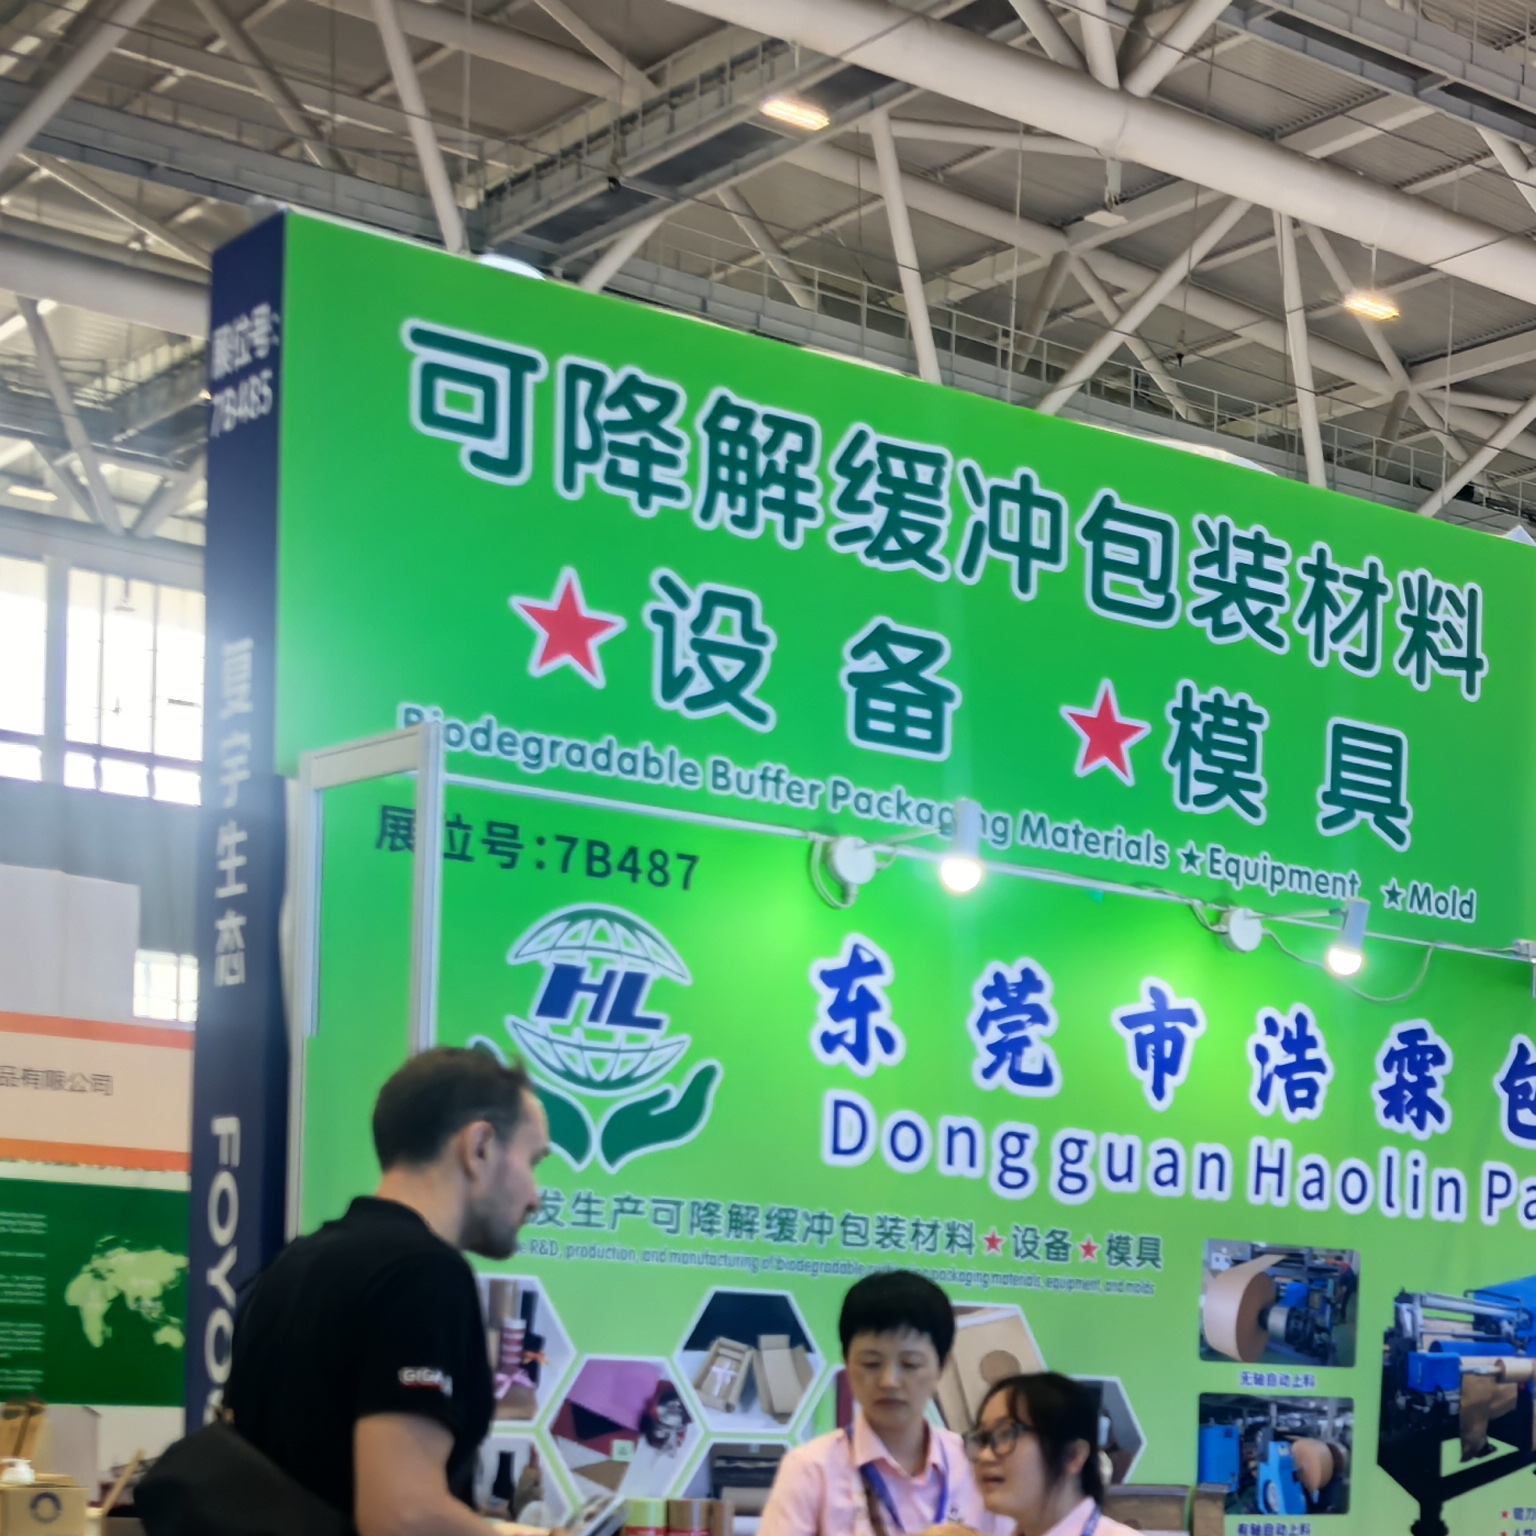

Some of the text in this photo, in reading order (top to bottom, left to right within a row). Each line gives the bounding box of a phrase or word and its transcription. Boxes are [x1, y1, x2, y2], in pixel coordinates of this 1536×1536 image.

[405, 322, 1485, 698] 可降解缓冲包装材料
[646, 570, 1412, 851] 设备 模具
[398, 703, 1476, 921] Bodegradable Buffer Packagg Materials Equipment Mold
[535, 963, 664, 1031] HL
[827, 1095, 1229, 1199] Dongguan
[1252, 1141, 1465, 1218] Haolin
[203, 1116, 241, 1425] FOYO
[643, 1248, 667, 1263] and
[1012, 1225, 1072, 1263] 设备
[1105, 1233, 1164, 1270] 模具
